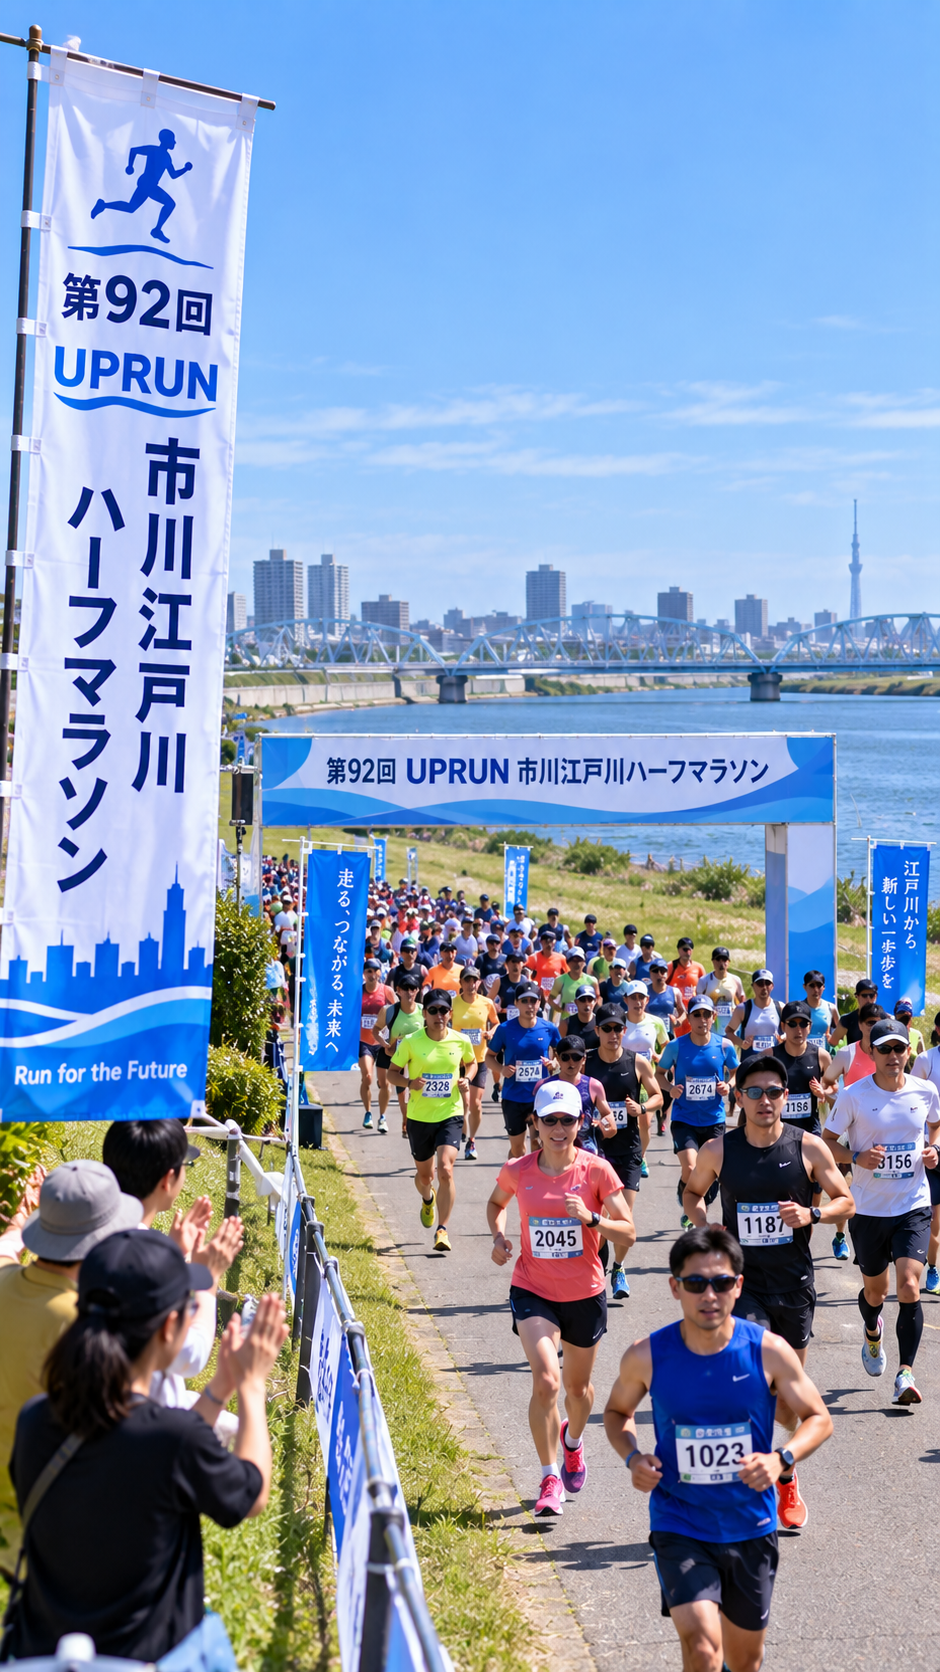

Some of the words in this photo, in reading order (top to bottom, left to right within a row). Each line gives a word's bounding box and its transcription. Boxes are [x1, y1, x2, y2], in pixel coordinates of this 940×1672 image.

[61, 272, 214, 337] 第92回
[53, 345, 218, 402] UPRUN
[131, 437, 200, 793] 市川江戸川
[57, 486, 125, 893] ハーフマラソン
[326, 757, 396, 785] 第92回
[406, 758, 509, 785] UPRUN
[517, 757, 769, 786] 市川江戸川ハーフマラソン
[903, 860, 920, 950] 江戸川から
[324, 867, 354, 1053] 走る、つながる、未来へ
[14, 1065, 52, 1086] Run
[57, 1062, 87, 1084] for
[91, 1062, 122, 1082] the
[127, 1060, 188, 1080] Future
[425, 1080, 450, 1092] 2328
[877, 1153, 912, 1170] 3156
[534, 1229, 577, 1248] 2045
[744, 1216, 785, 1234] 1187
[685, 1442, 745, 1468] 1023
